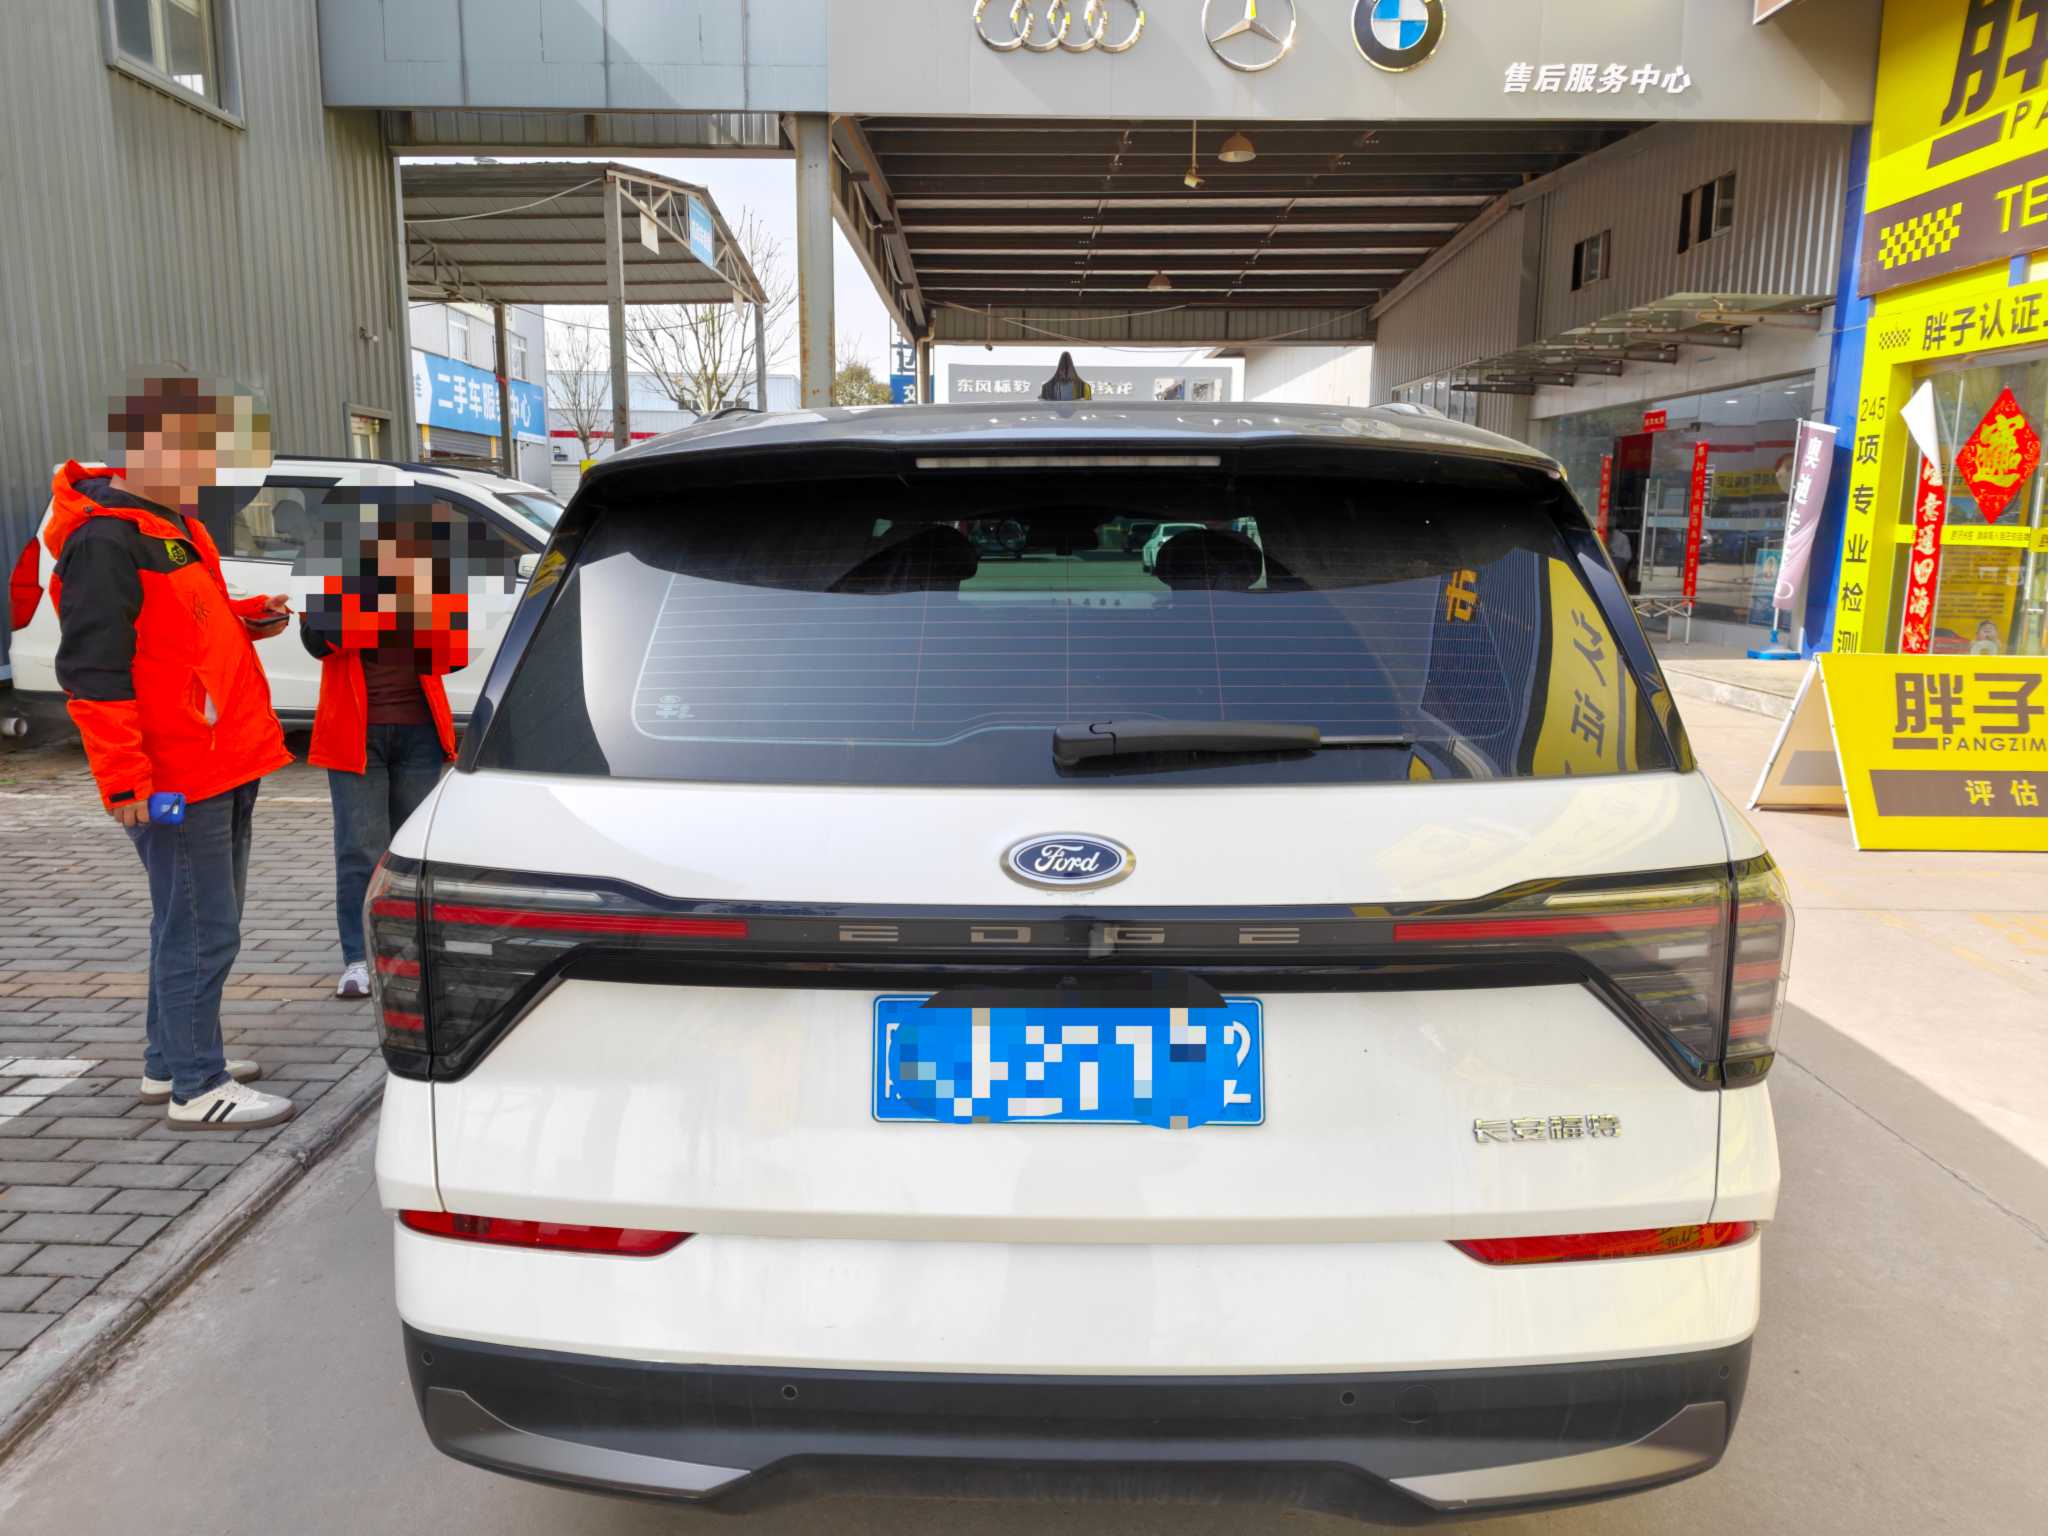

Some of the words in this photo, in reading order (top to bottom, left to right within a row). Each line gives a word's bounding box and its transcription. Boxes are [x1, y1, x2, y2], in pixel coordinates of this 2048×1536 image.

[1503, 62, 1692, 94] 售后服务中心
[1994, 175, 2048, 233] TE
[1922, 292, 2048, 351] 胖子认证
[437, 372, 532, 428] 二手车服中心
[1894, 672, 2045, 735] 胖子
[1942, 737, 2047, 752] PANGZIM
[1965, 779, 2039, 806] 评估
[1034, 844, 1100, 872] Ford
[838, 925, 1300, 945] EDGE
[1473, 1113, 1622, 1144] 长安福特
